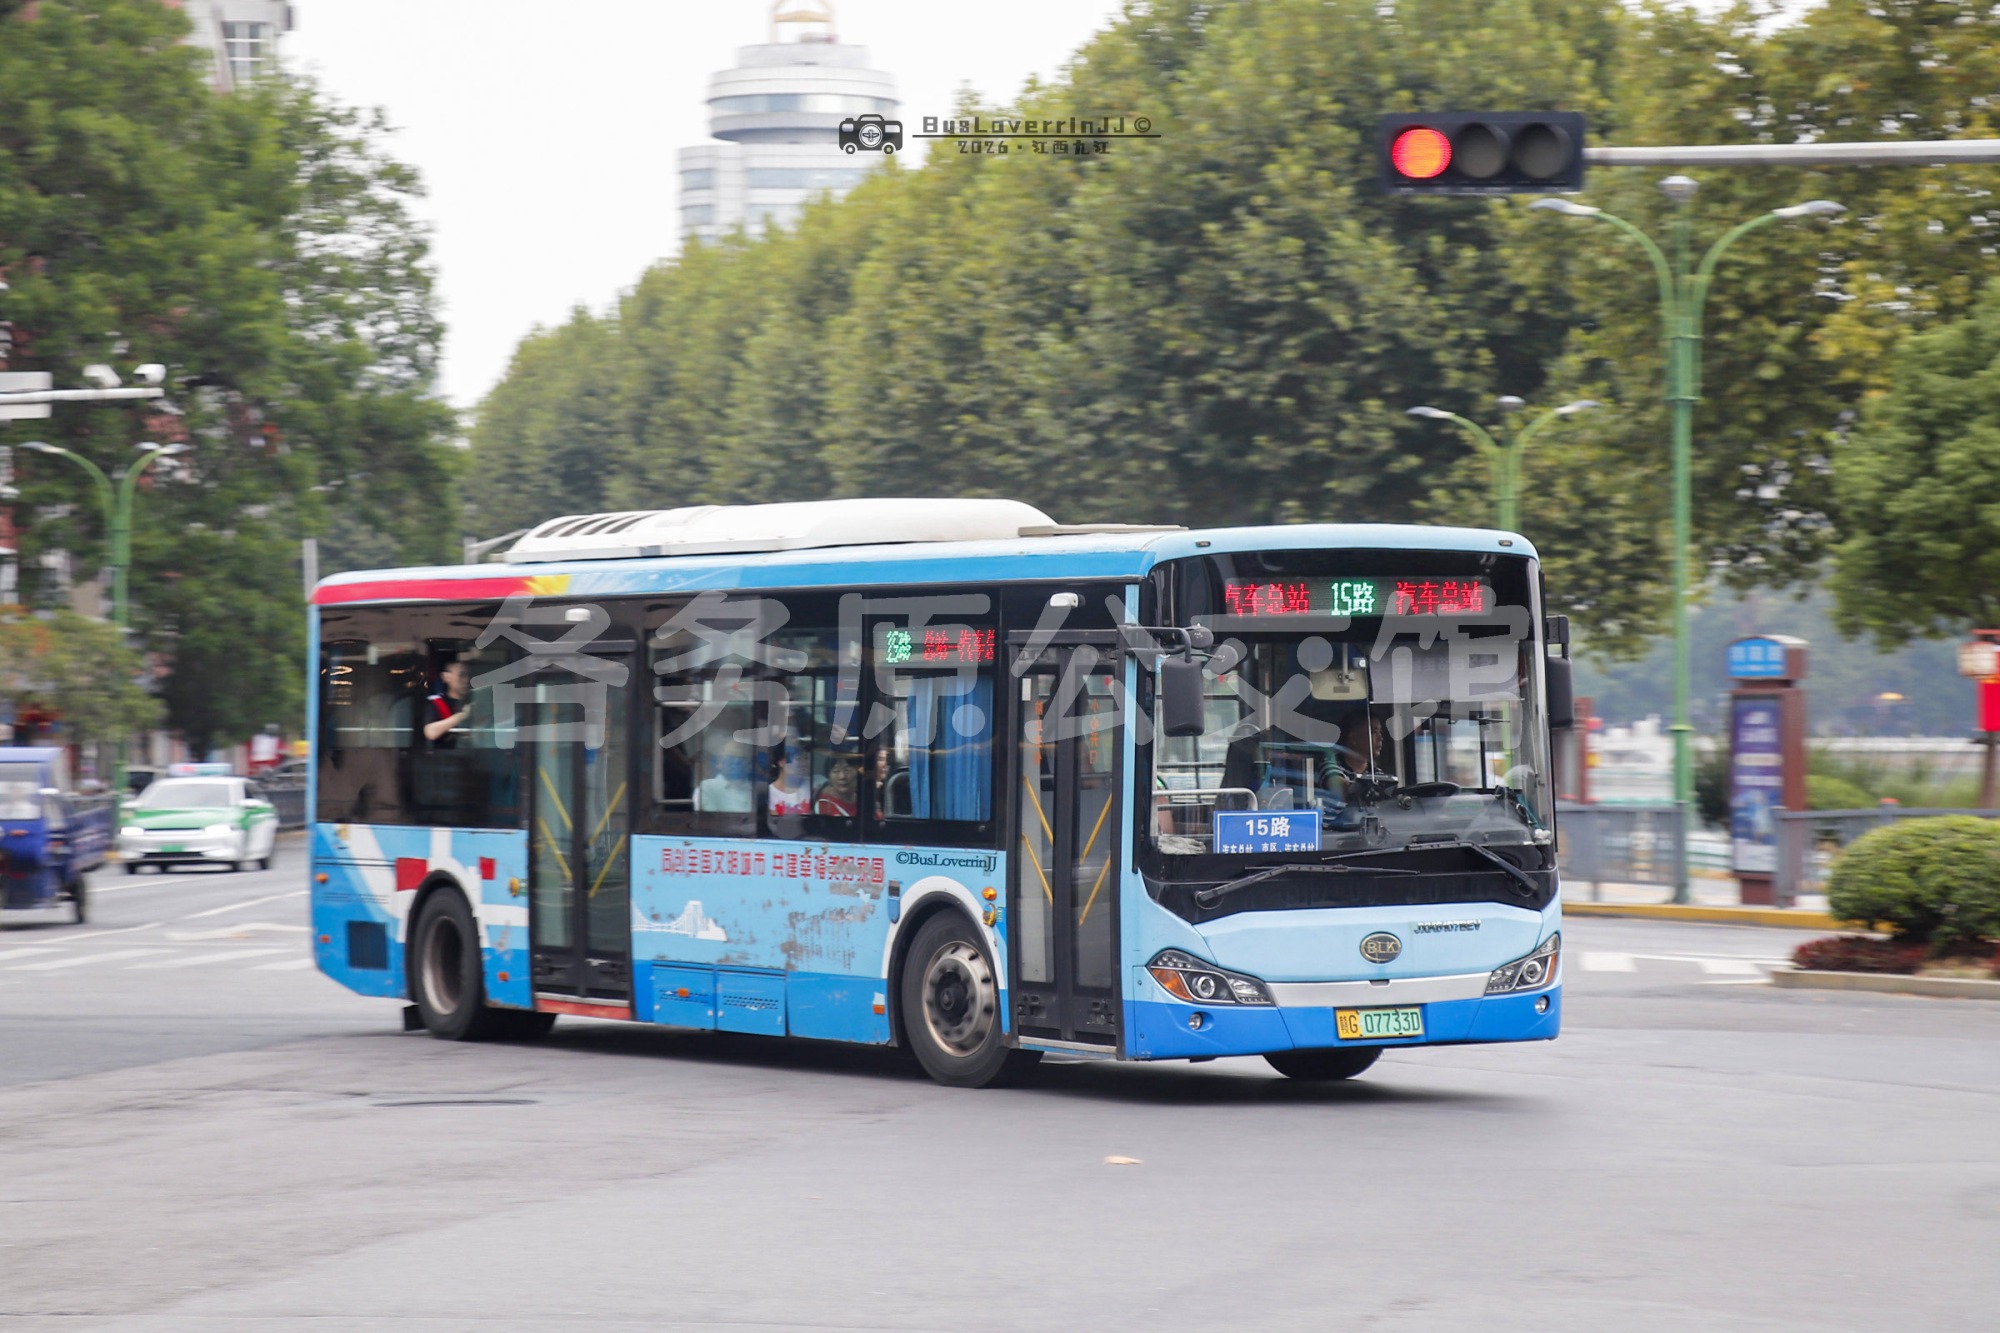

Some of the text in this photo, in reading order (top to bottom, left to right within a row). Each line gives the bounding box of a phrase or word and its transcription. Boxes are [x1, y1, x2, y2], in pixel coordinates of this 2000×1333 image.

[1331, 582, 1375, 616] 15路
[1395, 581, 1483, 615] 汽车总站
[1245, 816, 1290, 837] 15路
[1367, 941, 1398, 954] BLK
